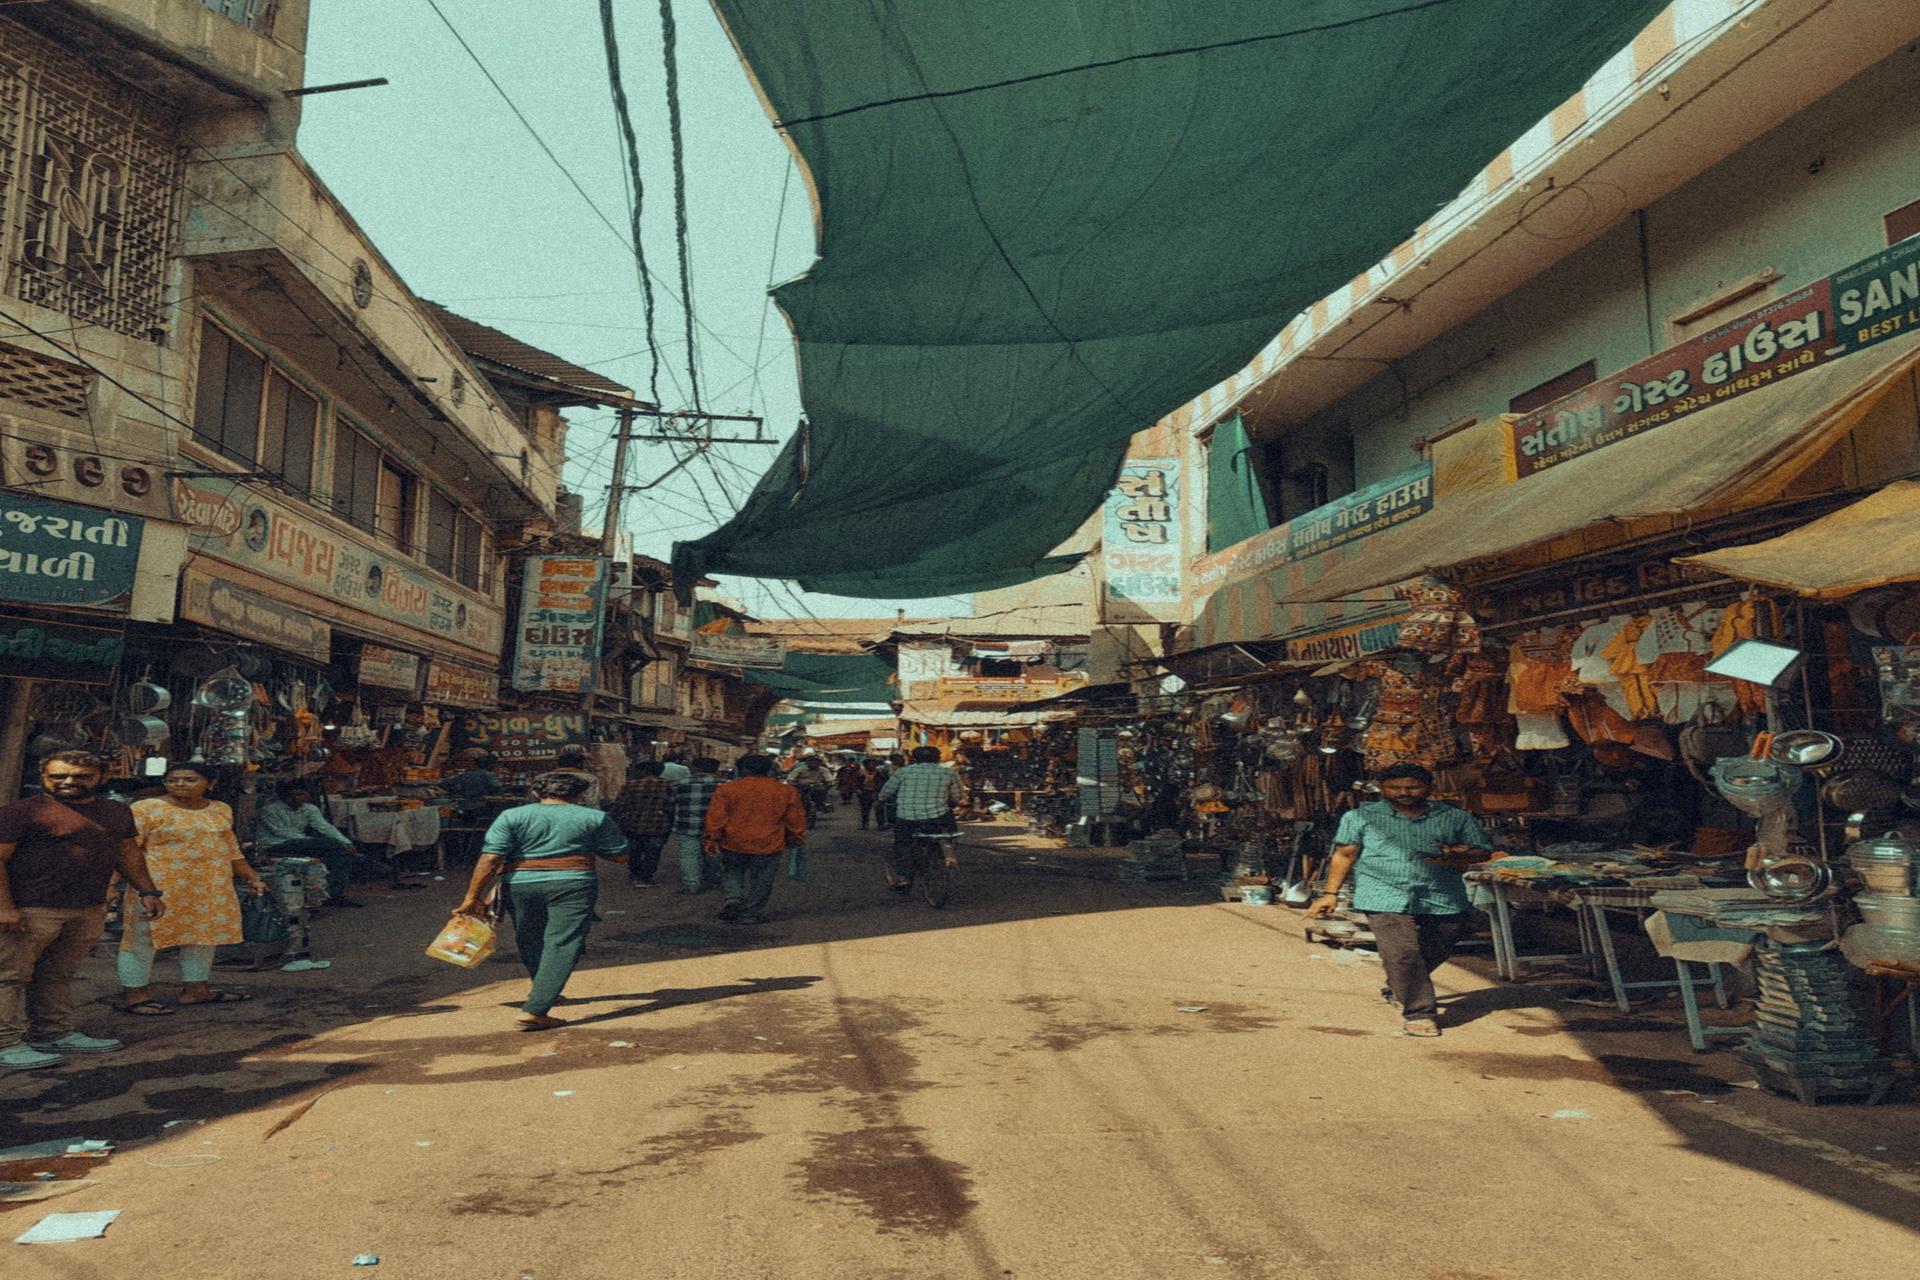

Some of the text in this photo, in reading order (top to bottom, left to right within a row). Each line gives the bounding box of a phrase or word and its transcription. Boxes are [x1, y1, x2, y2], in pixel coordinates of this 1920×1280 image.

[1839, 262, 1920, 325] SAN
[1857, 315, 1902, 343] BEST
[1777, 350, 1816, 375] સાથે
[1521, 404, 1605, 456] સંતોષ
[1613, 369, 1692, 413] ગેસ્ટ
[1702, 311, 1821, 386] હાઉસ
[1376, 476, 1432, 515] हाउस
[0, 509, 128, 547] જરાતી
[269, 512, 335, 583] વિજય
